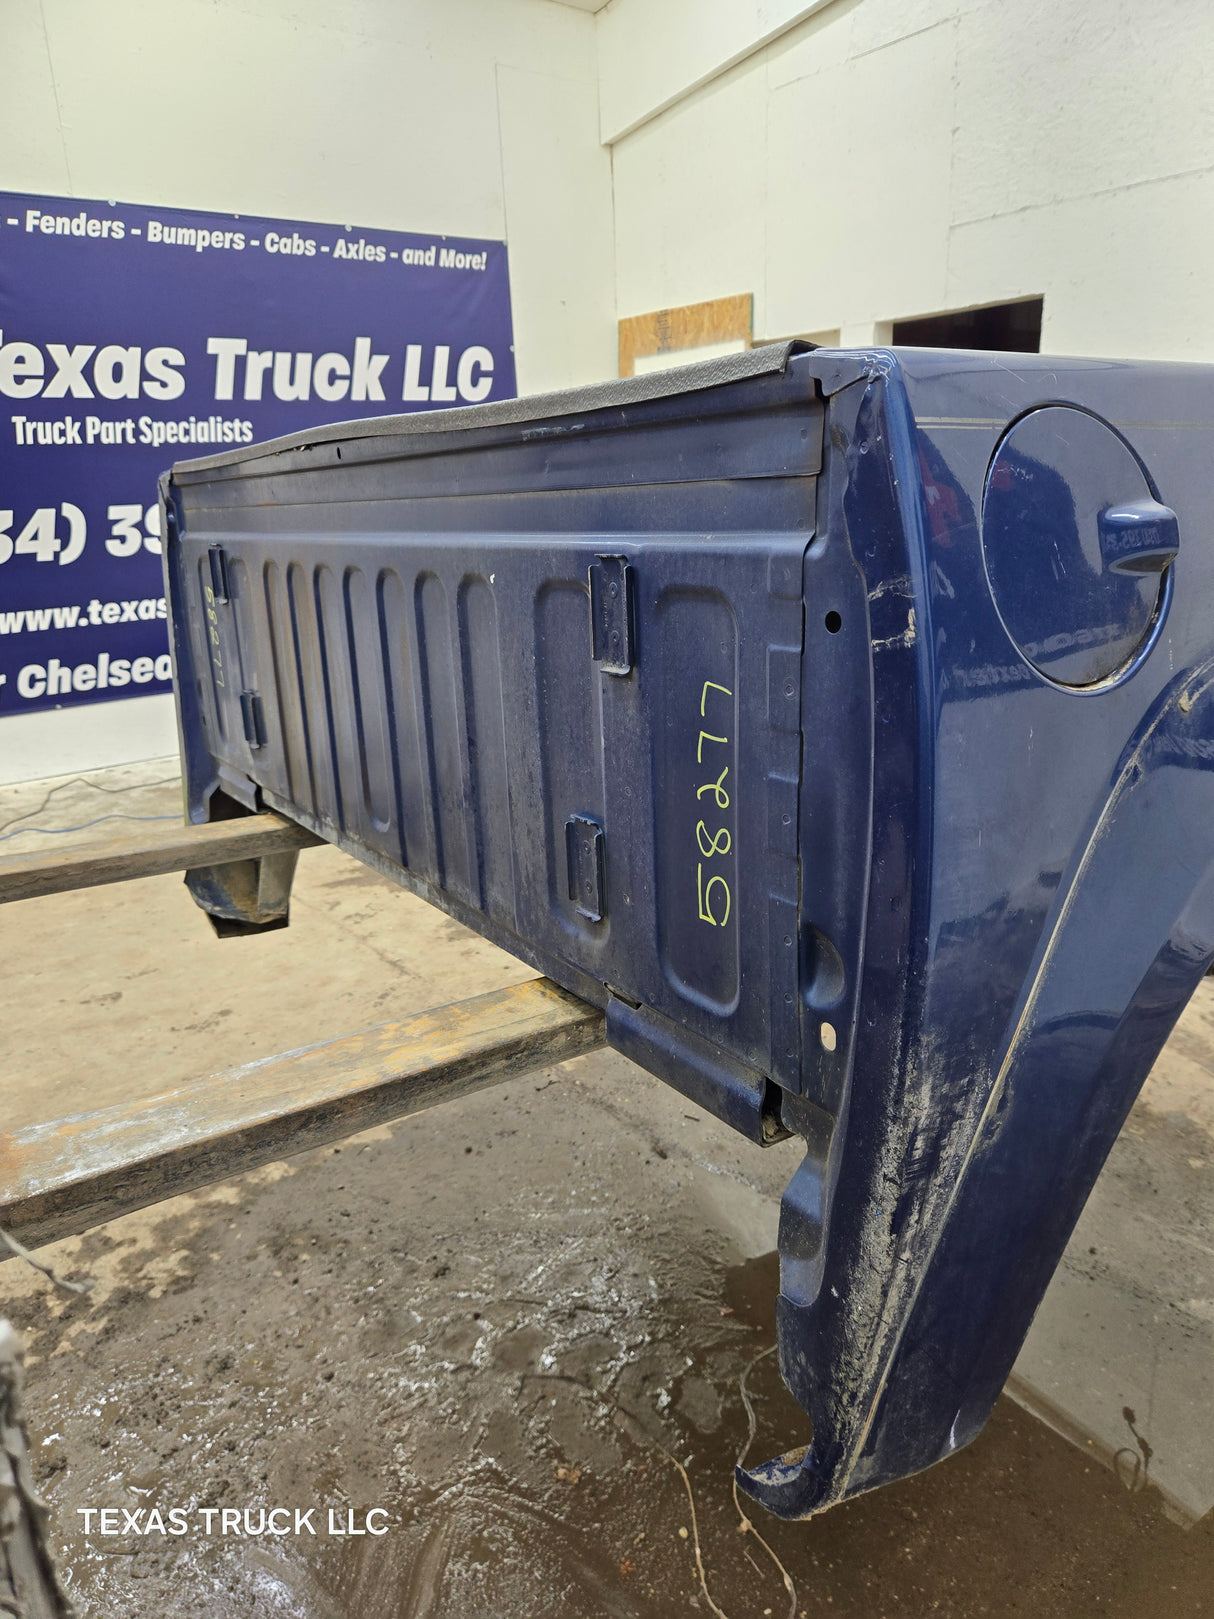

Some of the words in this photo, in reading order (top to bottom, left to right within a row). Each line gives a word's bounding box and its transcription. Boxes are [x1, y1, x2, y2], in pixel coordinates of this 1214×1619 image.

[26, 210, 126, 240] Fenders
[147, 221, 245, 253] Bumpers
[264, 232, 317, 257] Cabs
[333, 238, 387, 263] Axles
[402, 246, 437, 267] and
[438, 248, 488, 271] More!
[0, 329, 186, 400] exas
[206, 337, 390, 402] Truck
[402, 345, 494, 402] LLC
[11, 416, 81, 445] Truck
[86, 417, 135, 444] Part
[138, 417, 253, 448] Specialists
[696, 681, 733, 927] 58277
